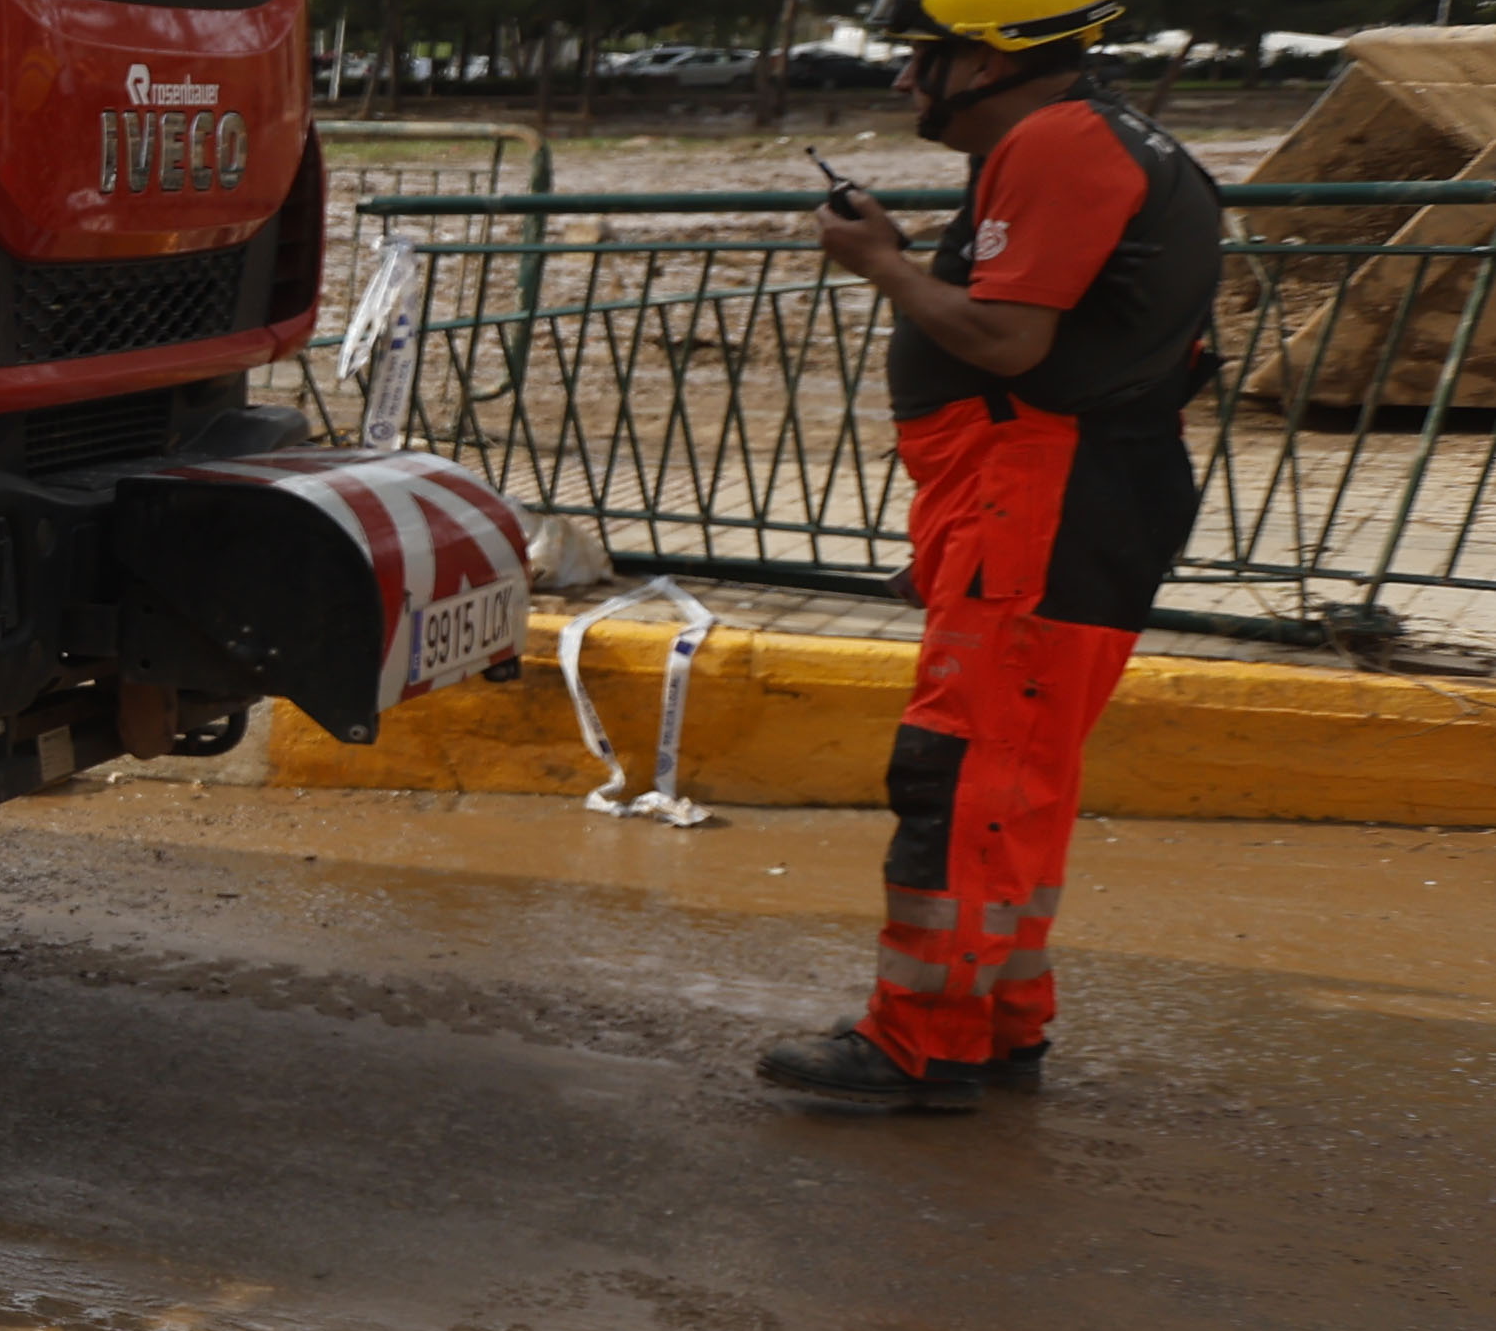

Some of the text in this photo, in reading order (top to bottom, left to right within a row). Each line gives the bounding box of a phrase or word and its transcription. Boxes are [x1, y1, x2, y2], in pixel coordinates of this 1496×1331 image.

[100, 109, 248, 192] IVECO
[426, 585, 513, 668] 9915 LCK
